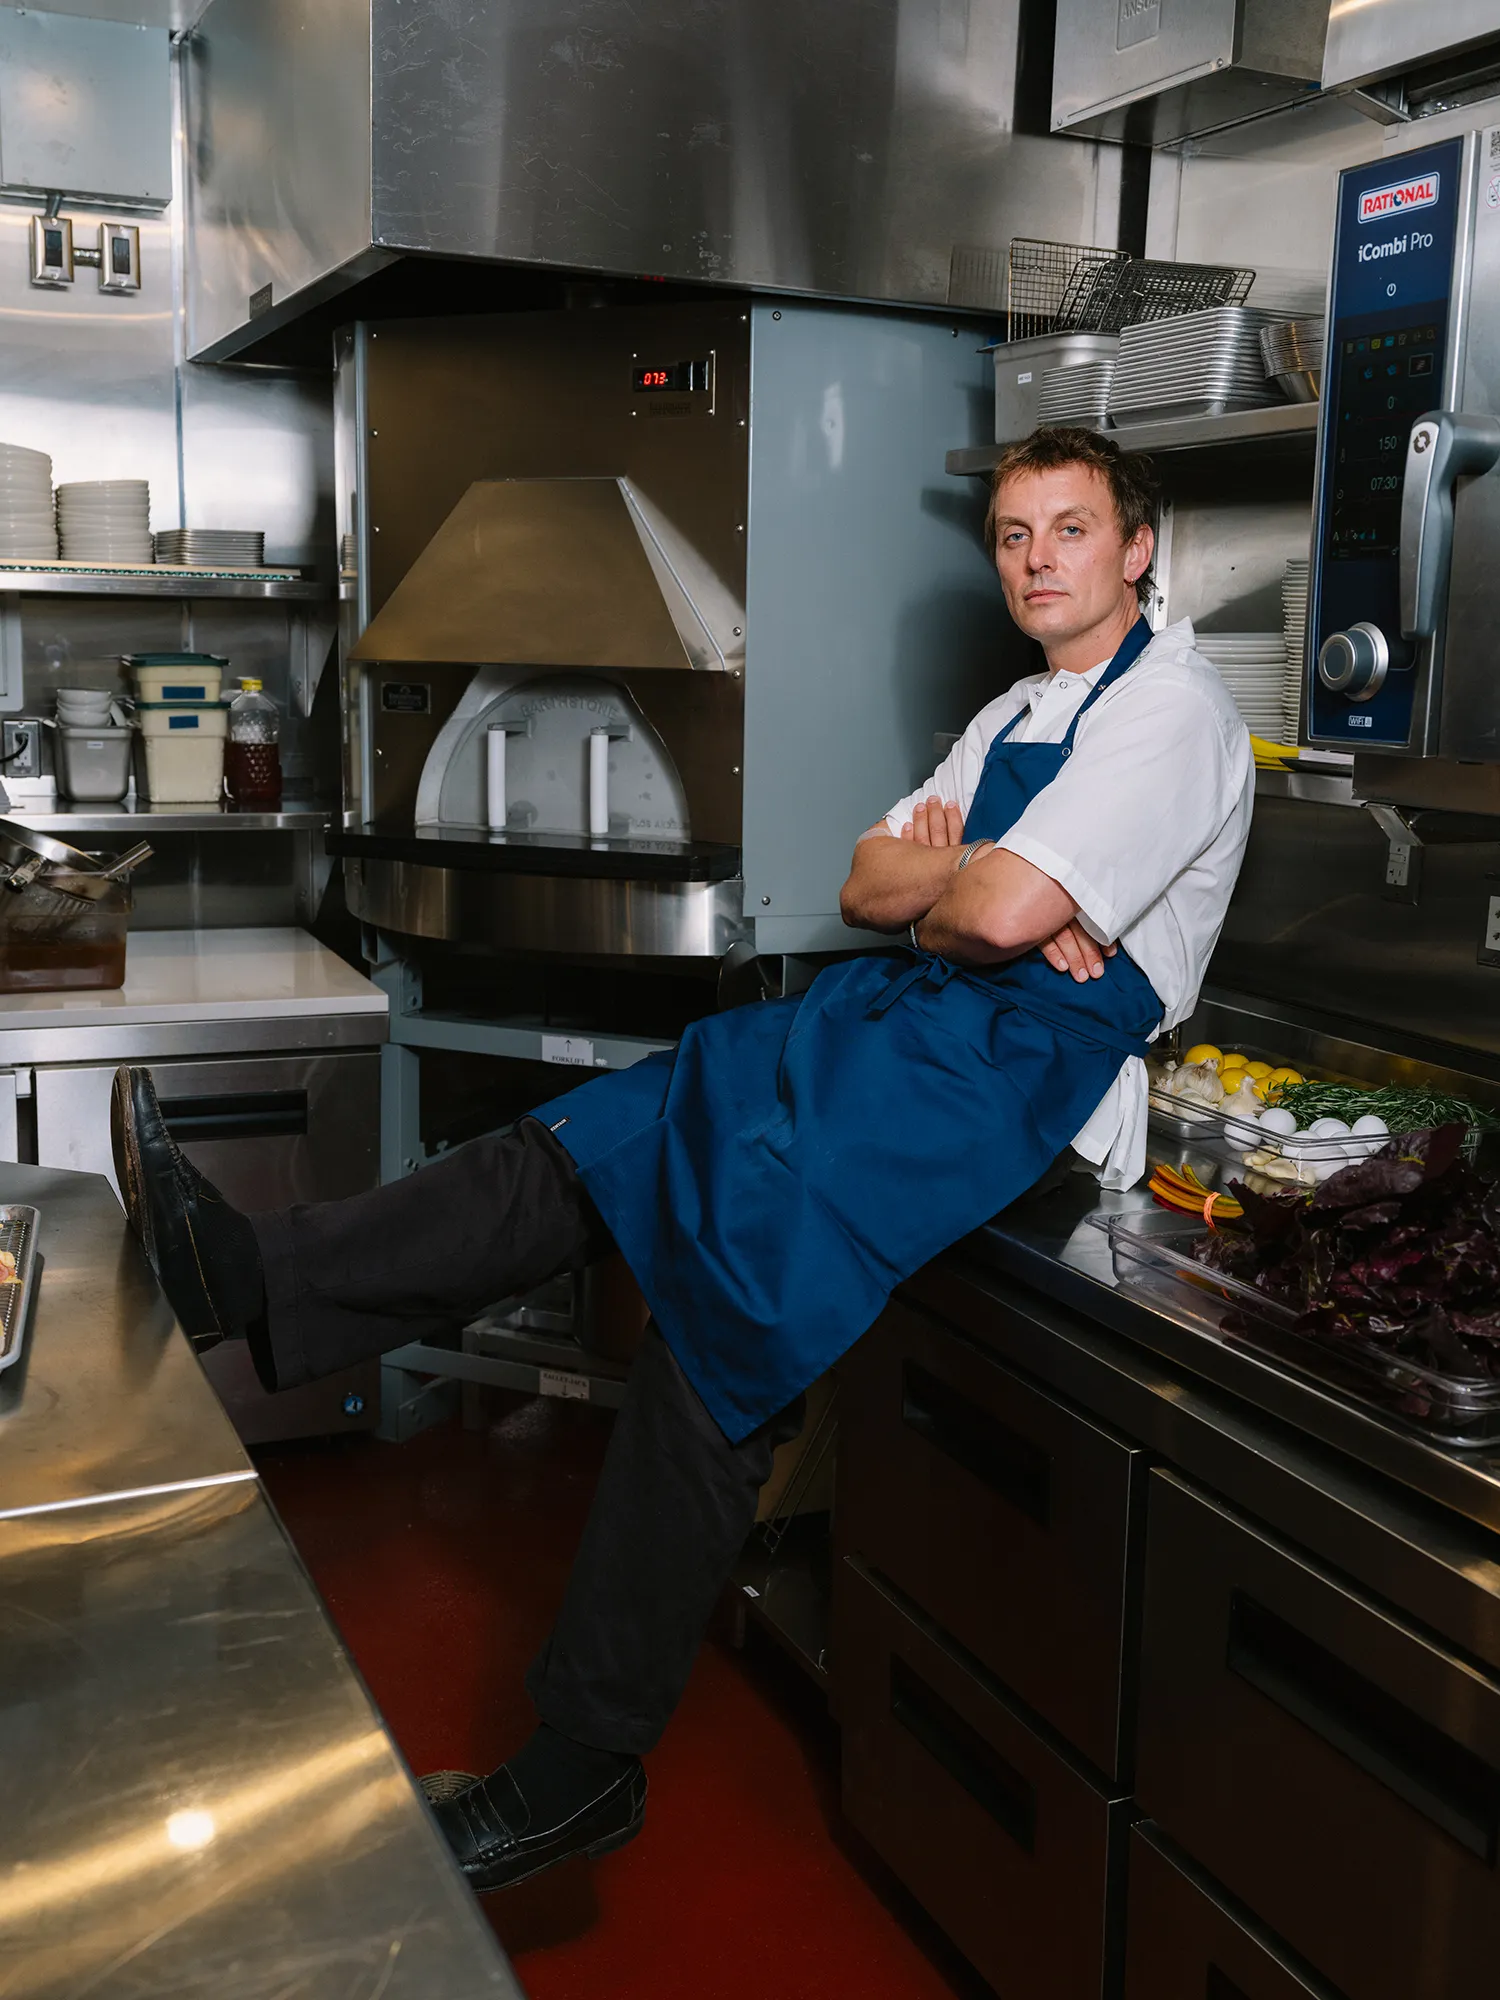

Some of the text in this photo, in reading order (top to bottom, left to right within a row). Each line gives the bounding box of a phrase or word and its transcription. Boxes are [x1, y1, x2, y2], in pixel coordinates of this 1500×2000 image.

[1363, 182, 1434, 214] RATIONAL
[1358, 231, 1433, 263] iCombi Pro
